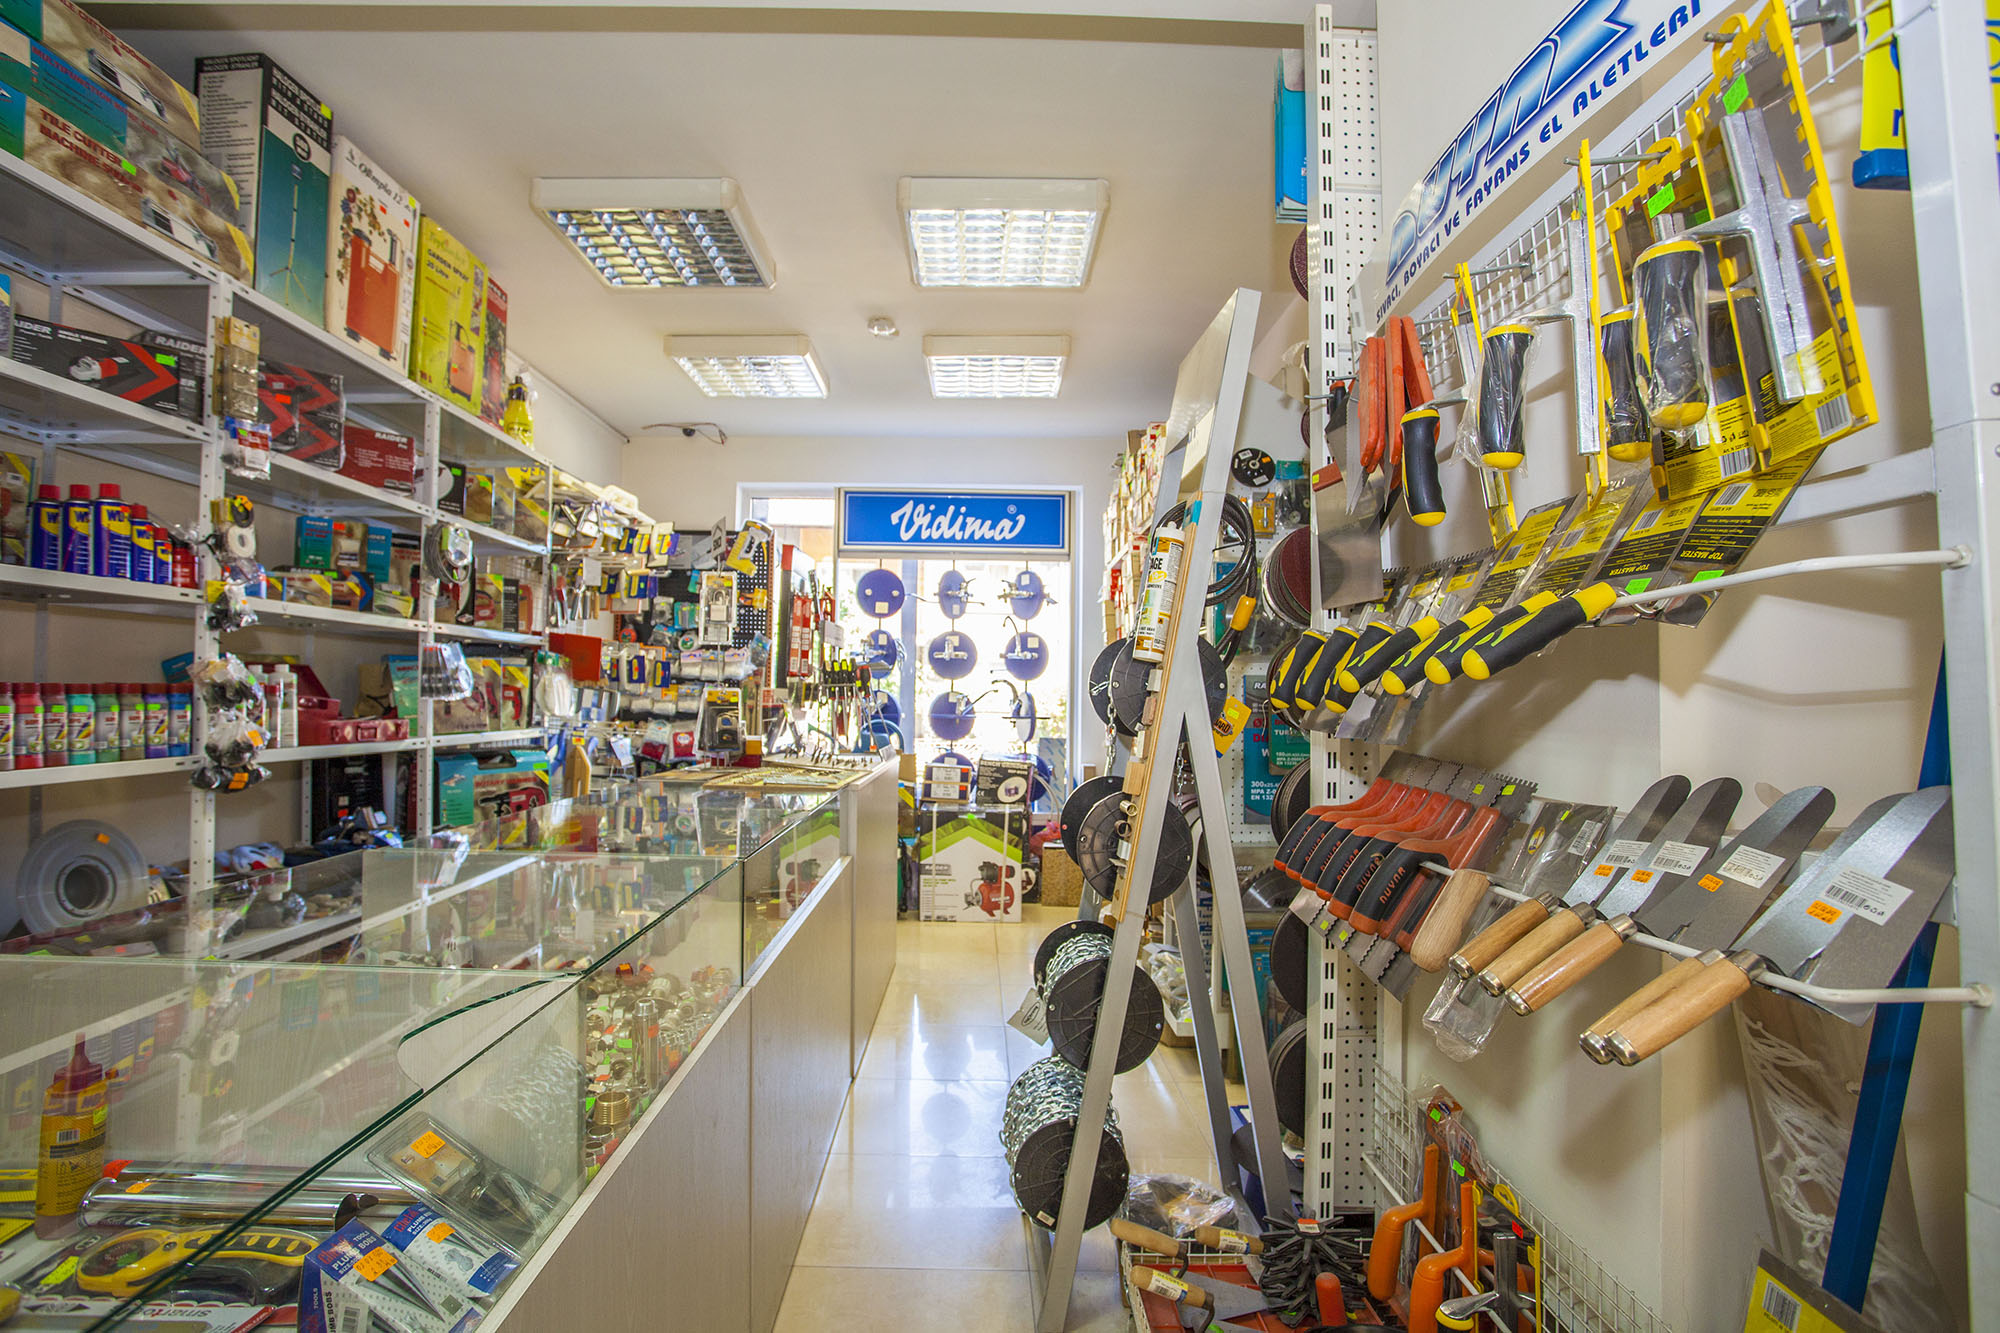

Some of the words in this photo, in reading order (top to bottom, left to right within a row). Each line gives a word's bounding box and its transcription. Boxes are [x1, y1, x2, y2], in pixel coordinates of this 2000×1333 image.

[40, 108, 71, 135] TILE
[72, 130, 122, 167] CUTTER
[1445, 209, 1460, 237] VE
[1465, 141, 1531, 217] FAYANS
[1539, 116, 1563, 143] EL
[393, 192, 403, 206] 12
[14, 319, 52, 334] AIDER
[155, 335, 207, 354] RAIDER
[374, 431, 408, 443] RAIDER
[890, 500, 1026, 541] Vidima
[1679, 550, 1709, 559] MASTER
[1708, 551, 1725, 560] TOP
[1149, 557, 1163, 570] AGE
[1635, 563, 1650, 572] TOP
[1608, 566, 1636, 576] MASTER
[352, 1230, 370, 1243] TOOLS
[358, 1235, 377, 1251] BOBS
